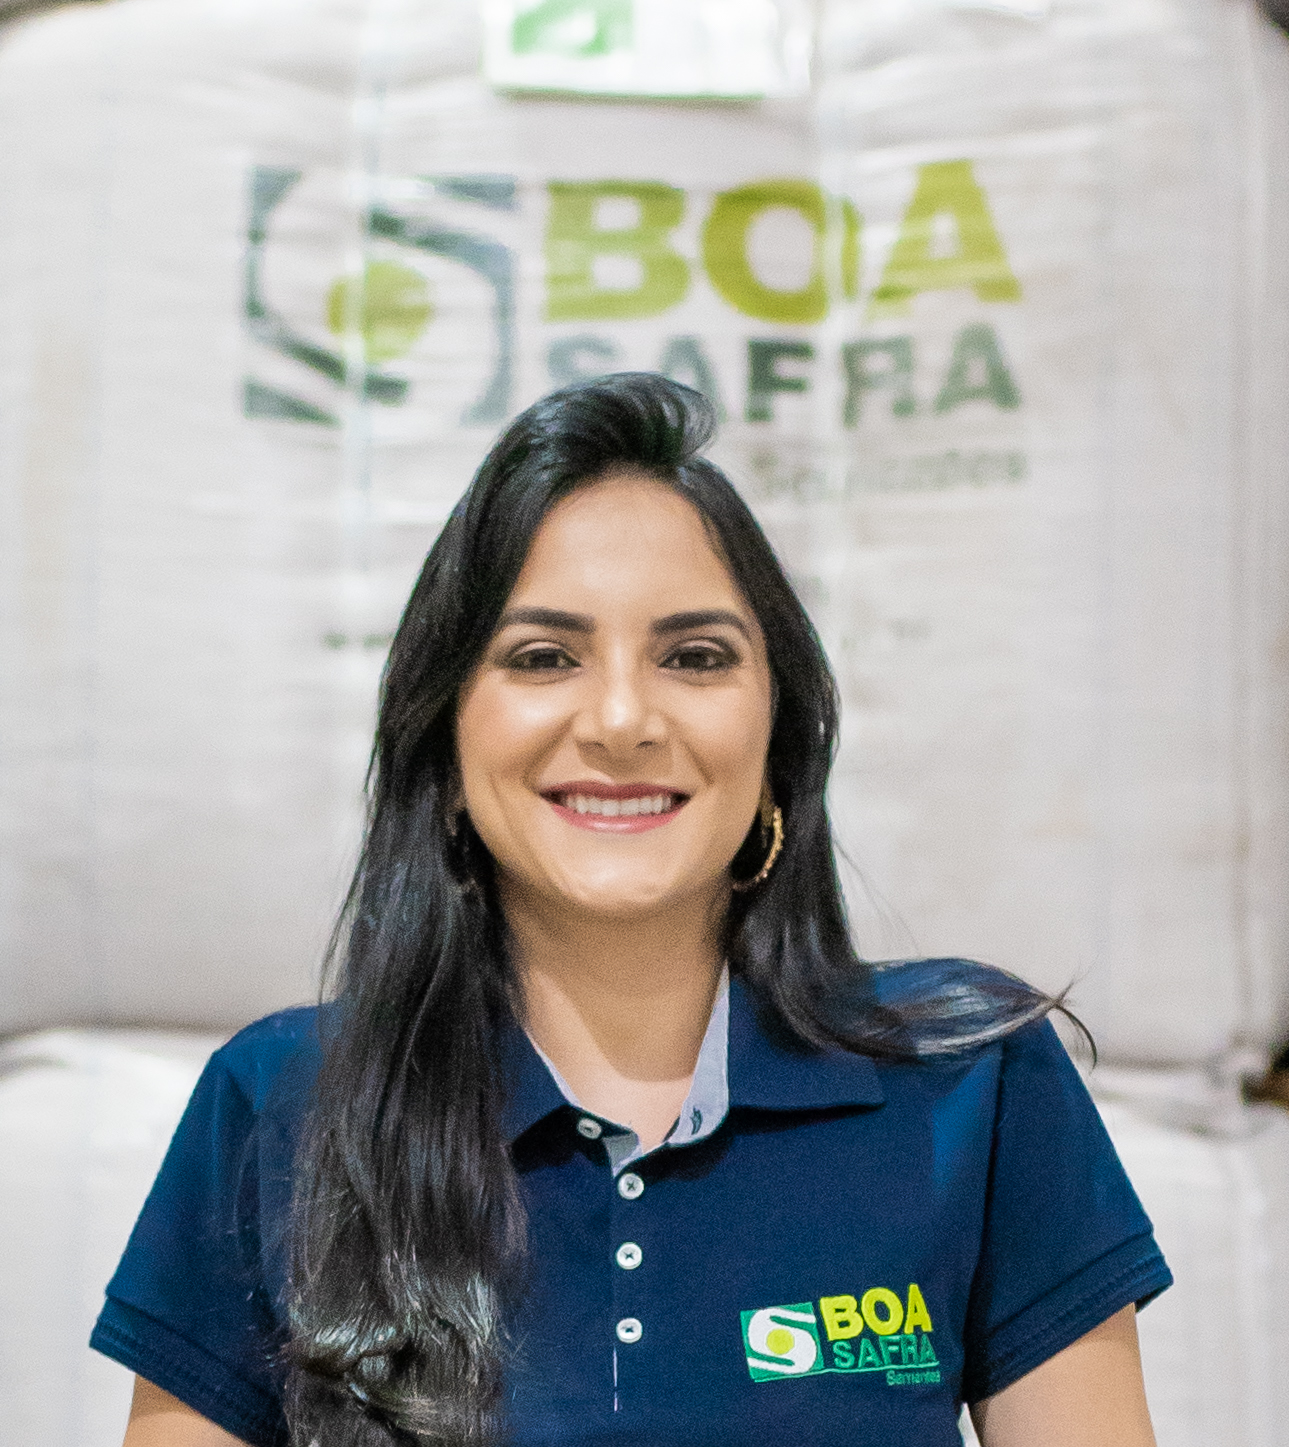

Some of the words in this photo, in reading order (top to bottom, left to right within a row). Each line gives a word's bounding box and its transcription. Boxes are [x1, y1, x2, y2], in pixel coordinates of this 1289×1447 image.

[541, 156, 1023, 325] BOA
[819, 1282, 933, 1341] BOA
[832, 1334, 937, 1368] SAFRA
